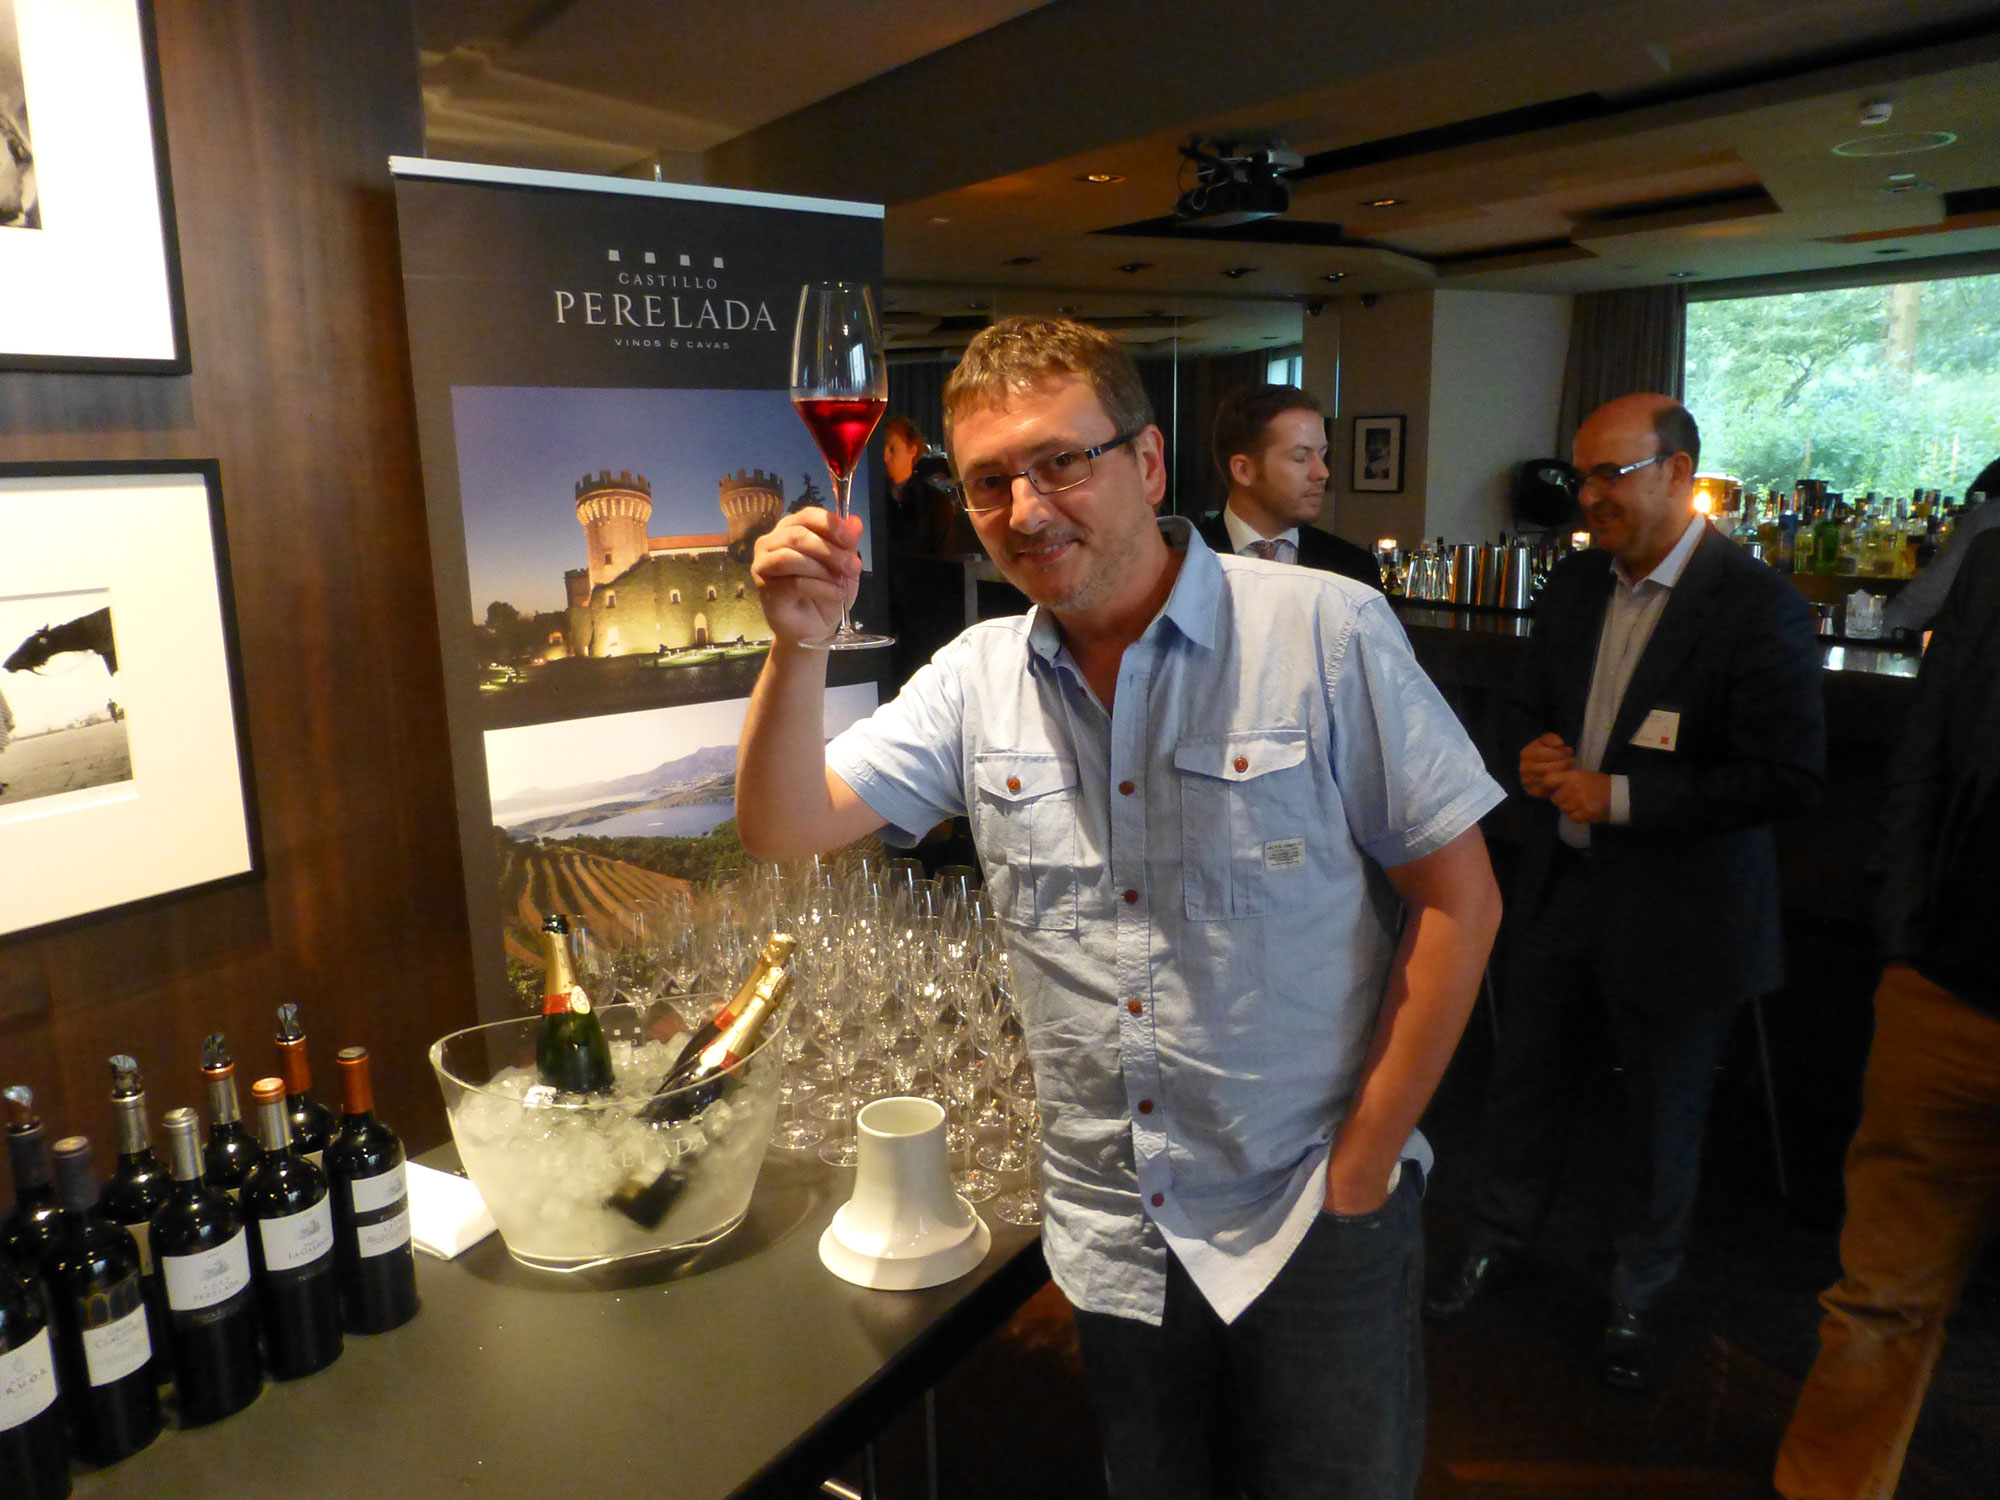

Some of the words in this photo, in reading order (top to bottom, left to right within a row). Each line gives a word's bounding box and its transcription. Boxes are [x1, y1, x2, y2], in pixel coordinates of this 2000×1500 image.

[618, 272, 718, 290] CASTILLO
[554, 290, 777, 332] PERELADA
[614, 338, 662, 349] VINOS
[670, 338, 679, 349] &
[686, 341, 730, 350] CAVAS
